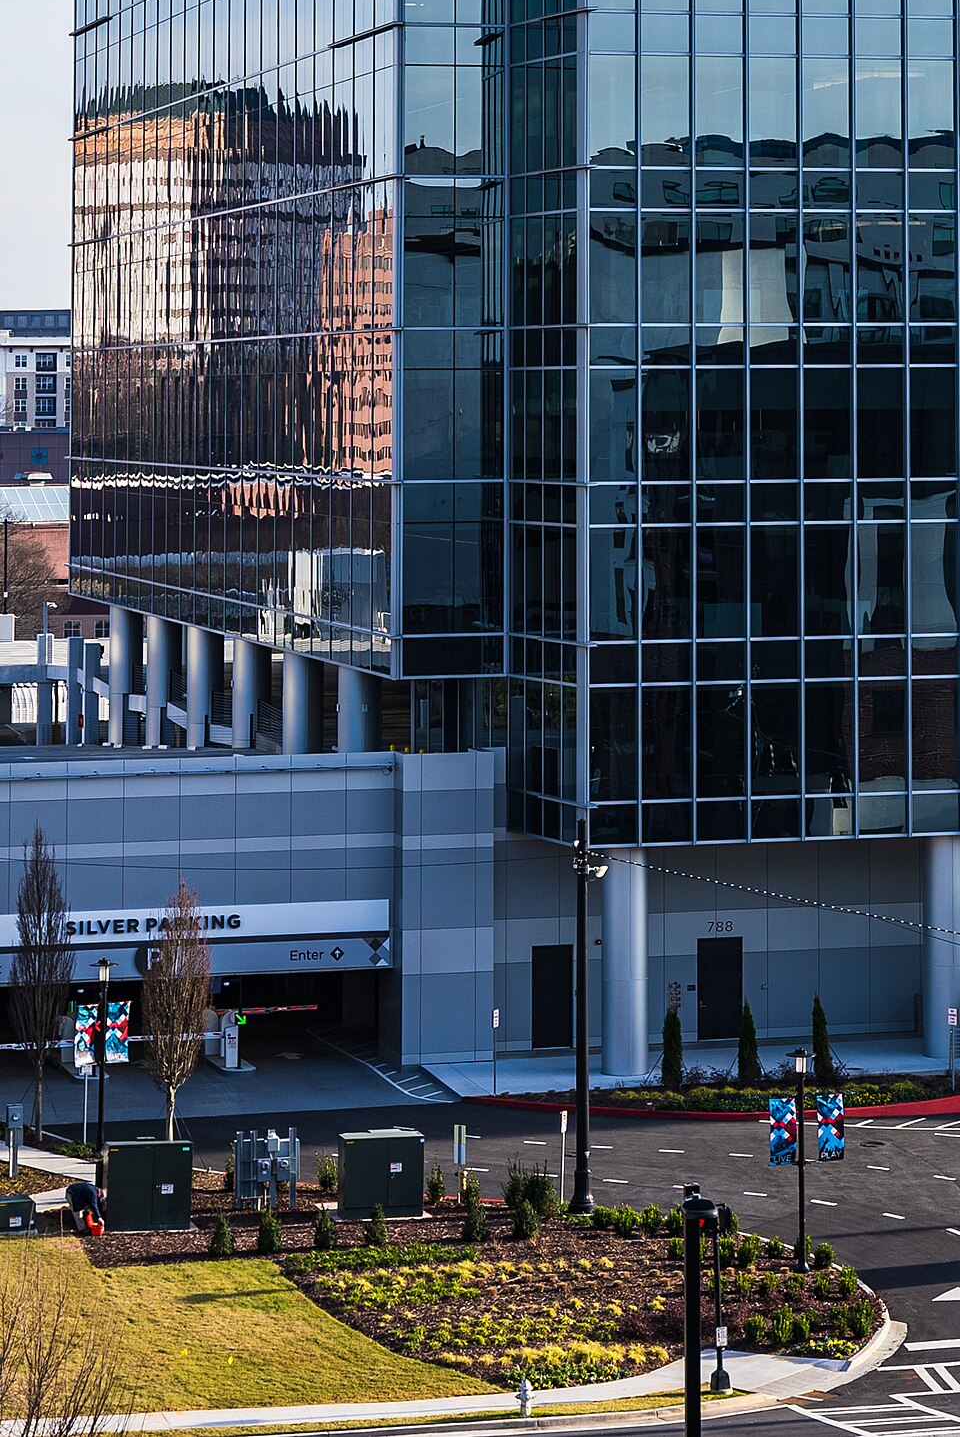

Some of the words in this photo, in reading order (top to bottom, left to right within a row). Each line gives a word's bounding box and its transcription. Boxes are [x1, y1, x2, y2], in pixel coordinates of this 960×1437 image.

[65, 918, 140, 936] SILVER
[707, 920, 734, 933] 788
[289, 949, 325, 962] Enter
[773, 1154, 792, 1163] LIVE
[820, 1150, 842, 1159] PLAY
